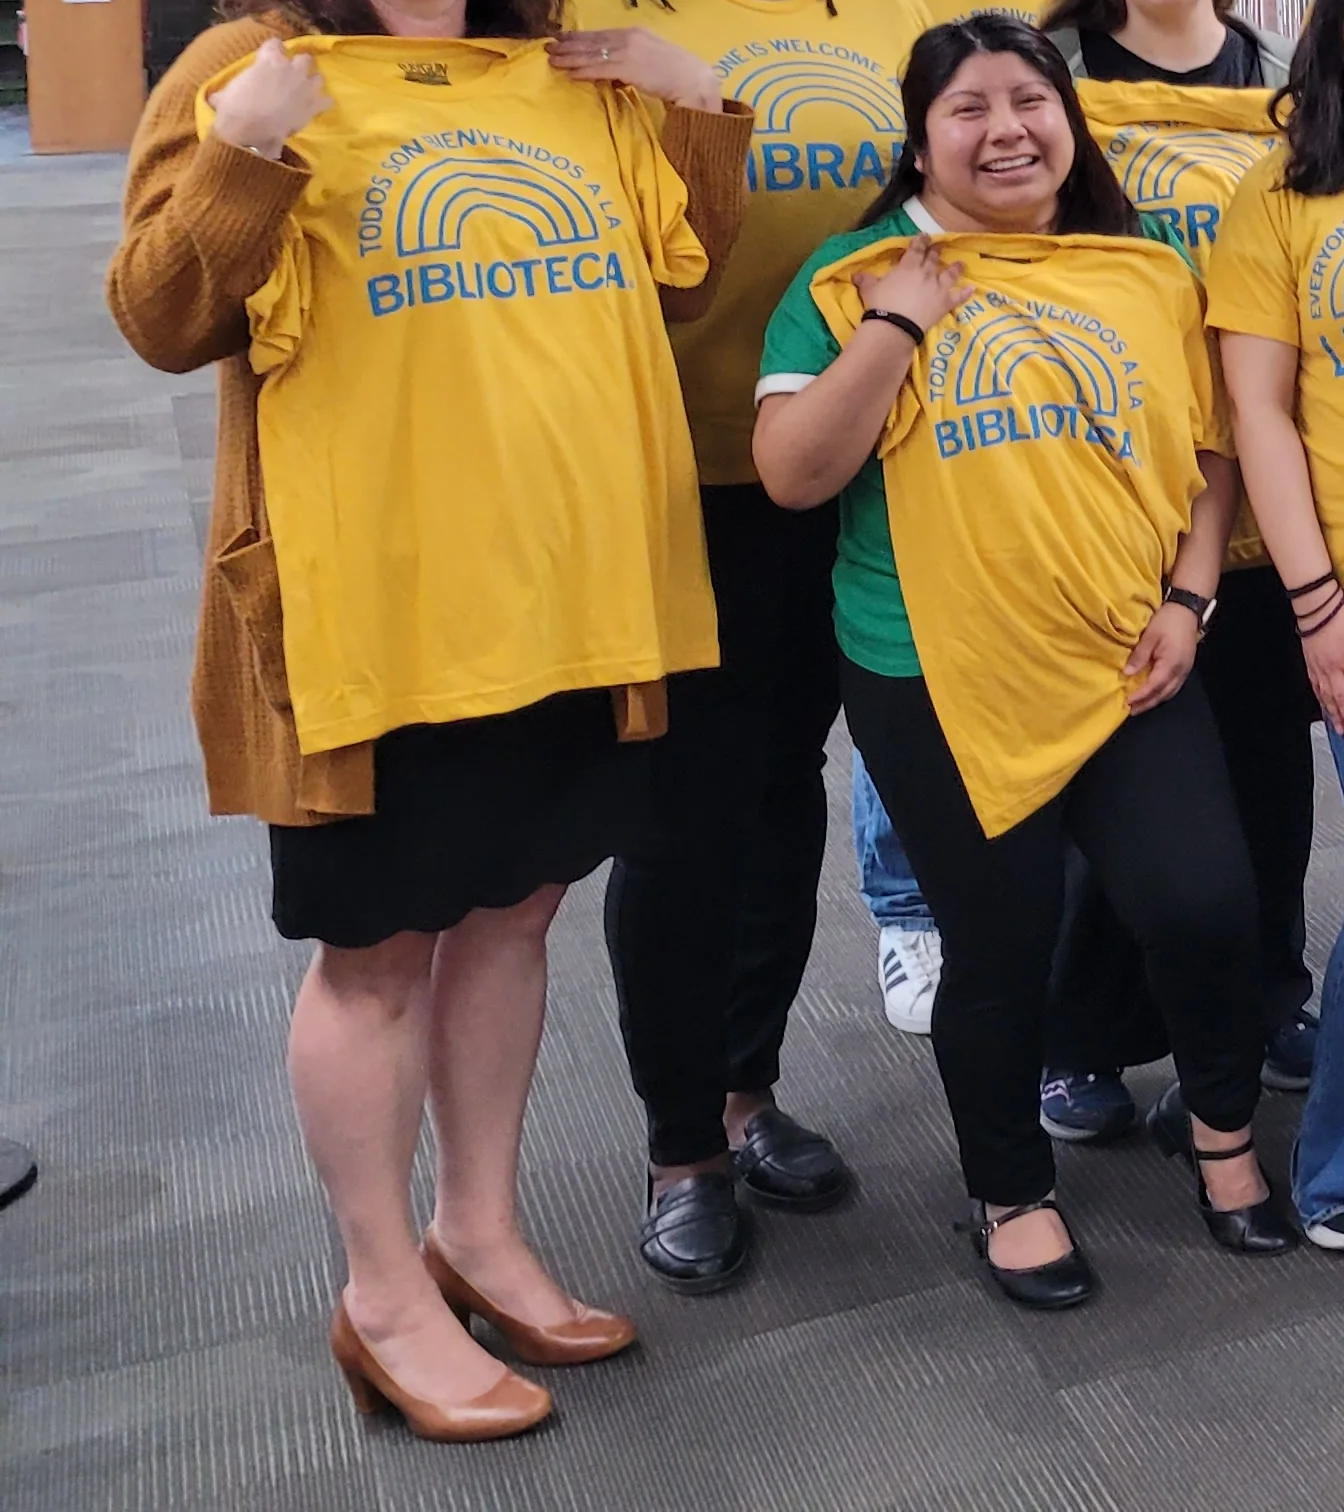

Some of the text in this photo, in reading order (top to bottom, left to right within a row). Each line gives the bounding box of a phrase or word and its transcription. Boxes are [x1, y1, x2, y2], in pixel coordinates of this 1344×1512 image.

[748, 41, 769, 60] IS
[768, 38, 884, 75] WELCOME
[357, 128, 623, 258] TODOS SON BIENVENIDOS A LA
[746, 141, 902, 193] IBRA
[367, 252, 626, 317] BIBLIOTECA
[929, 329, 962, 402] TODOS
[1121, 360, 1138, 375] A
[1127, 380, 1144, 410] LA
